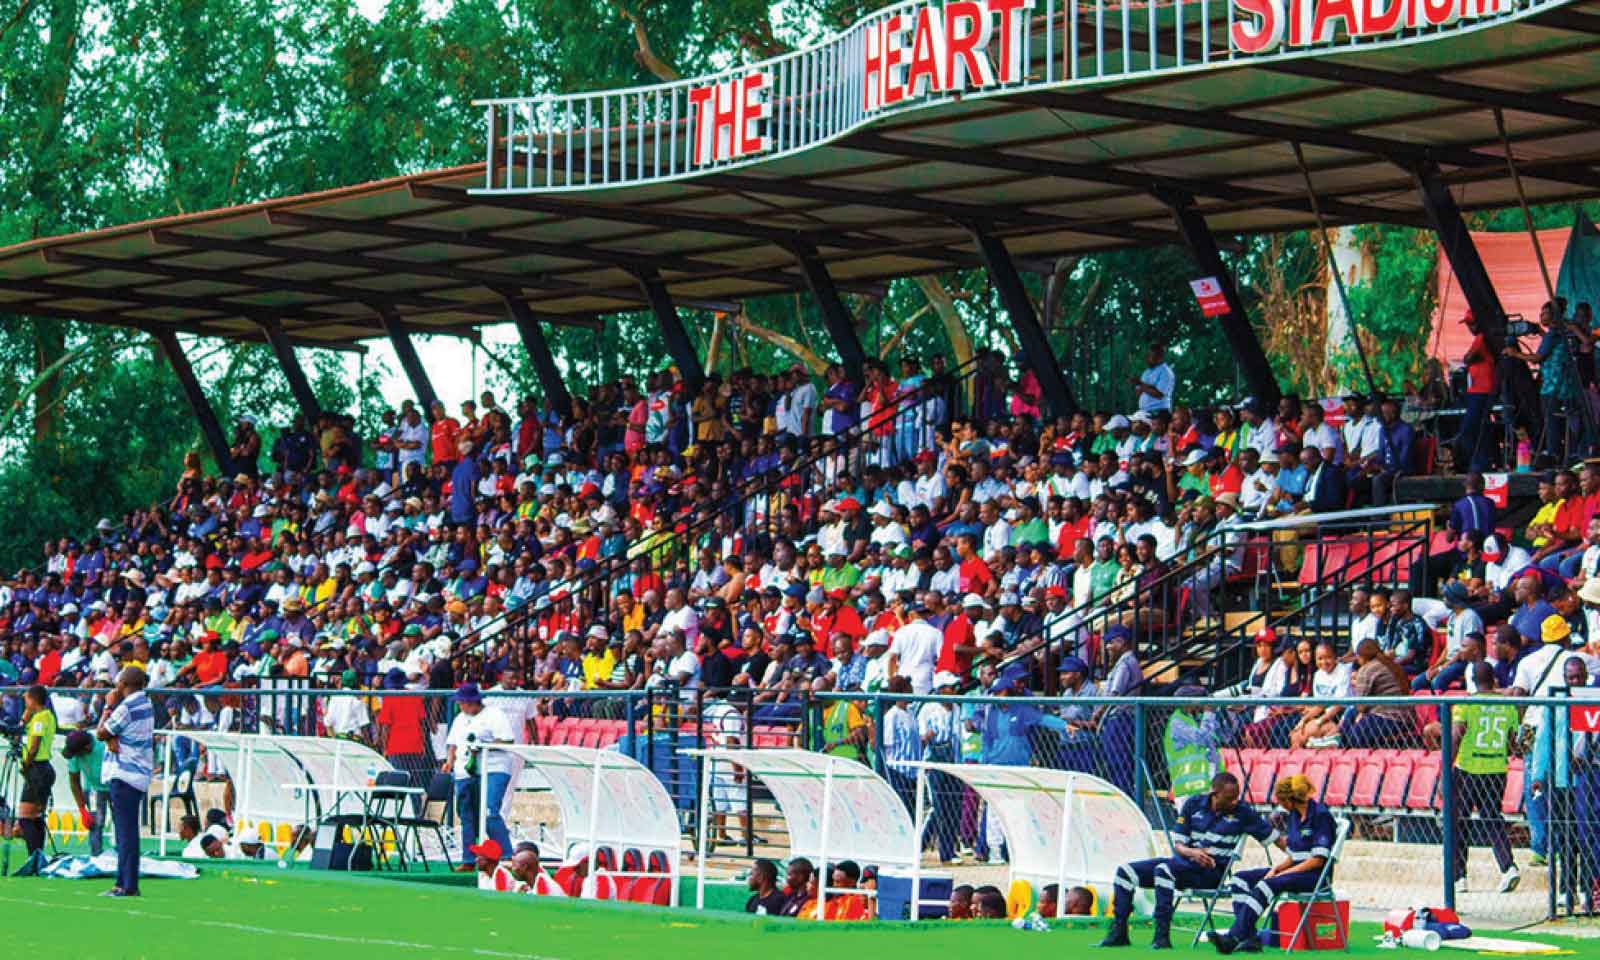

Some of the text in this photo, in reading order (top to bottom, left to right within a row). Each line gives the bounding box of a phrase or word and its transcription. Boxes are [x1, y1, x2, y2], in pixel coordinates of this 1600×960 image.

[689, 0, 1512, 165] THE HEART STAD
[1475, 716, 1507, 749] 25
